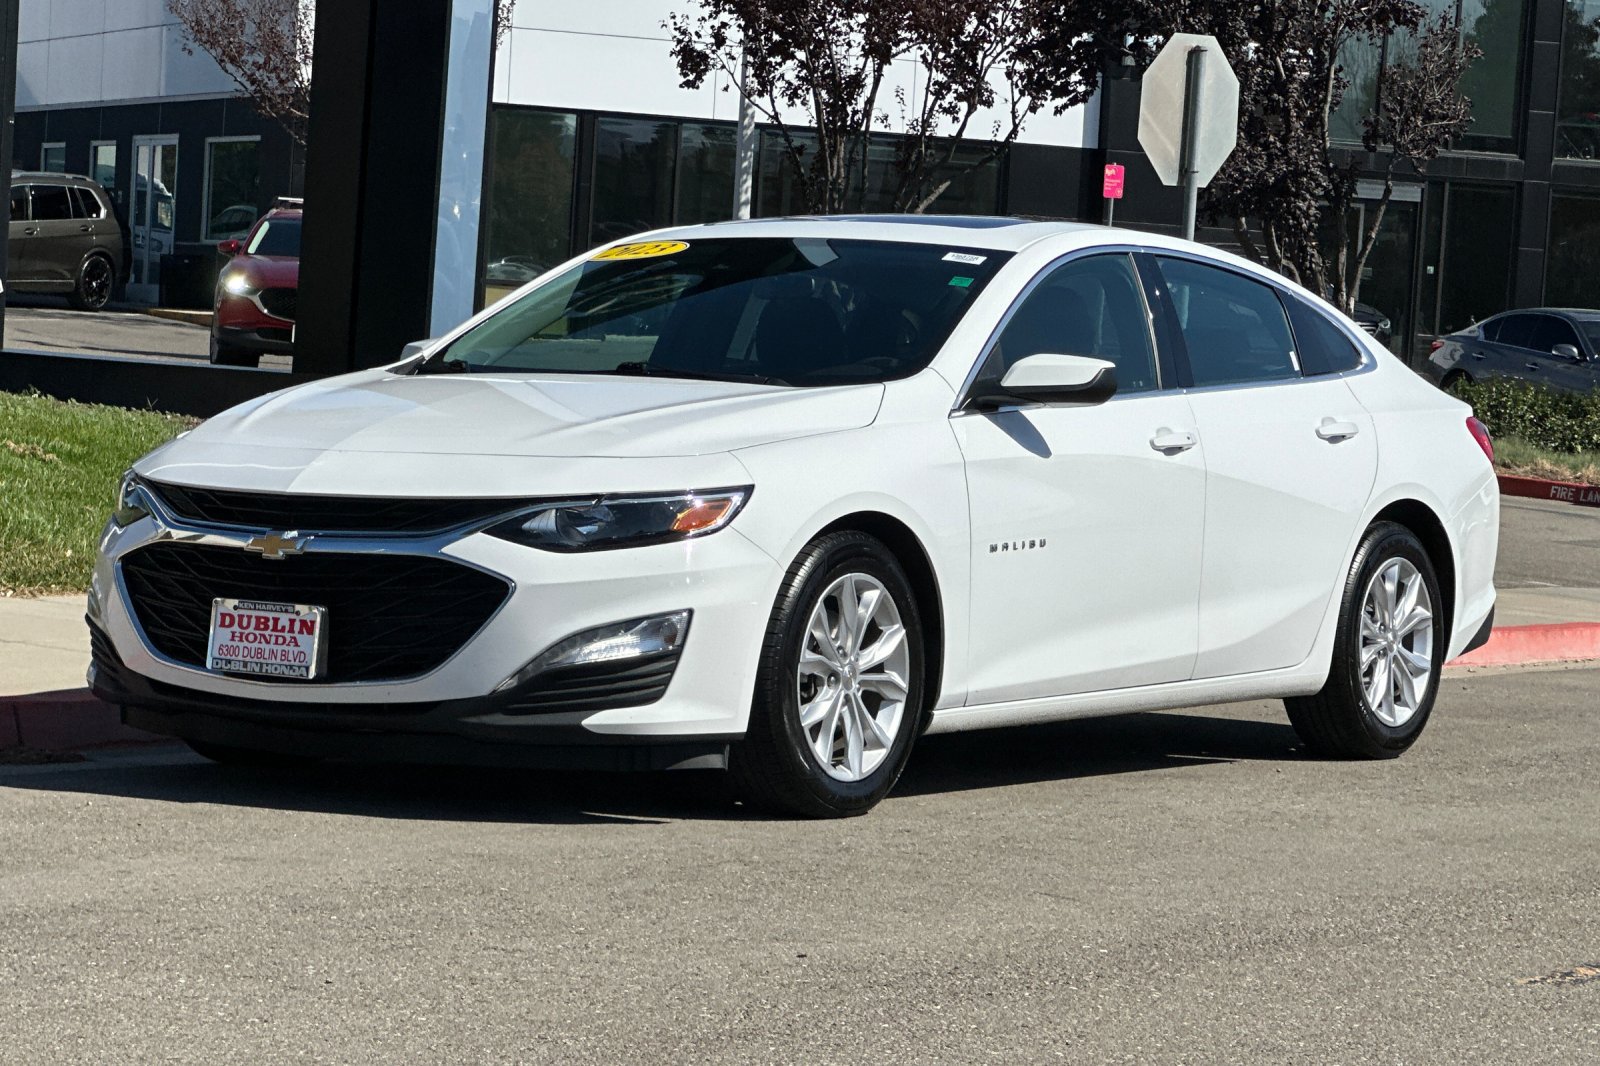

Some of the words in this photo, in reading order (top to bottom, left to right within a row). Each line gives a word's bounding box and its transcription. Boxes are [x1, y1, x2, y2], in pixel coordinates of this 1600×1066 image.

[1550, 486, 1576, 500] FIRE
[989, 539, 1046, 553] MALIBU
[239, 602, 254, 610] KEN
[219, 613, 315, 635] DUBLIN
[230, 631, 300, 647] HONDA
[218, 644, 241, 658] 6300
[241, 646, 279, 661] DUBLIN
[280, 649, 309, 665] BLVD.
